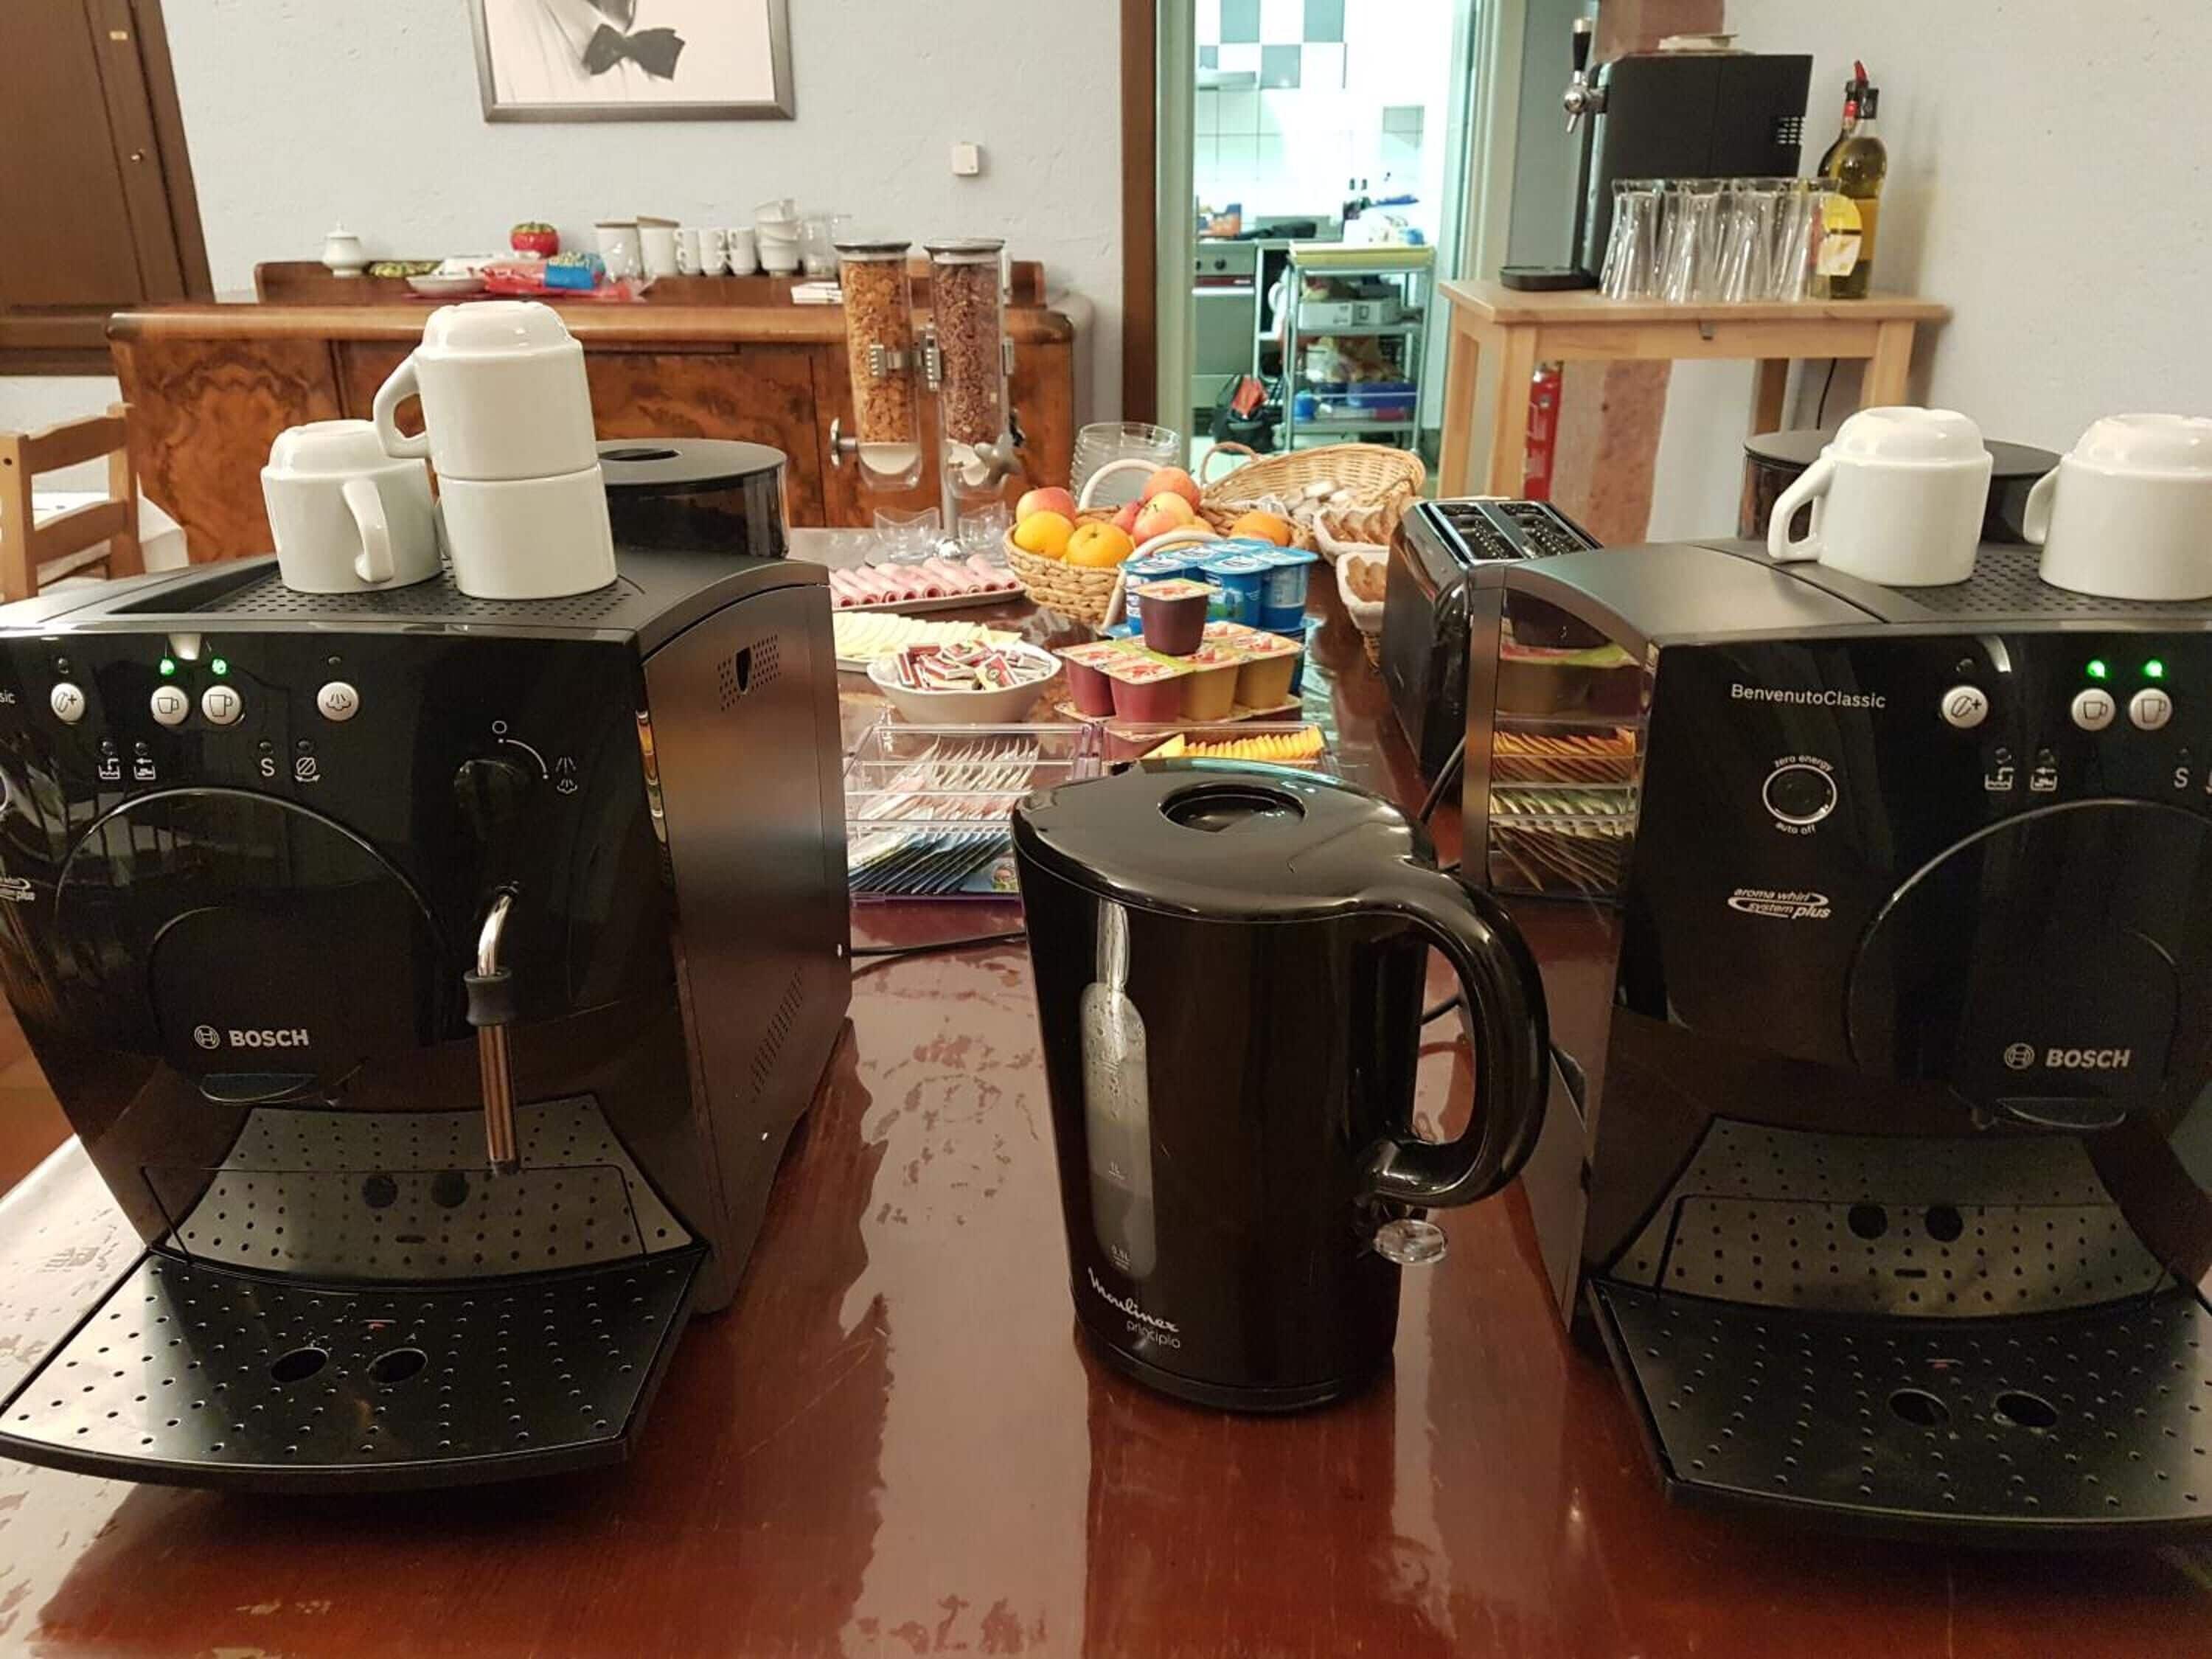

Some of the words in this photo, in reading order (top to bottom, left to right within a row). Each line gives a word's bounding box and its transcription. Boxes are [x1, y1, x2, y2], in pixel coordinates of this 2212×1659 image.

[1731, 683, 1887, 708] BenvenutoClassic
[1733, 888, 1775, 899] aroma
[1791, 904, 1832, 919] plus
[229, 1029, 310, 1047] BOSCH
[2045, 1048, 2131, 1068] BOSCH
